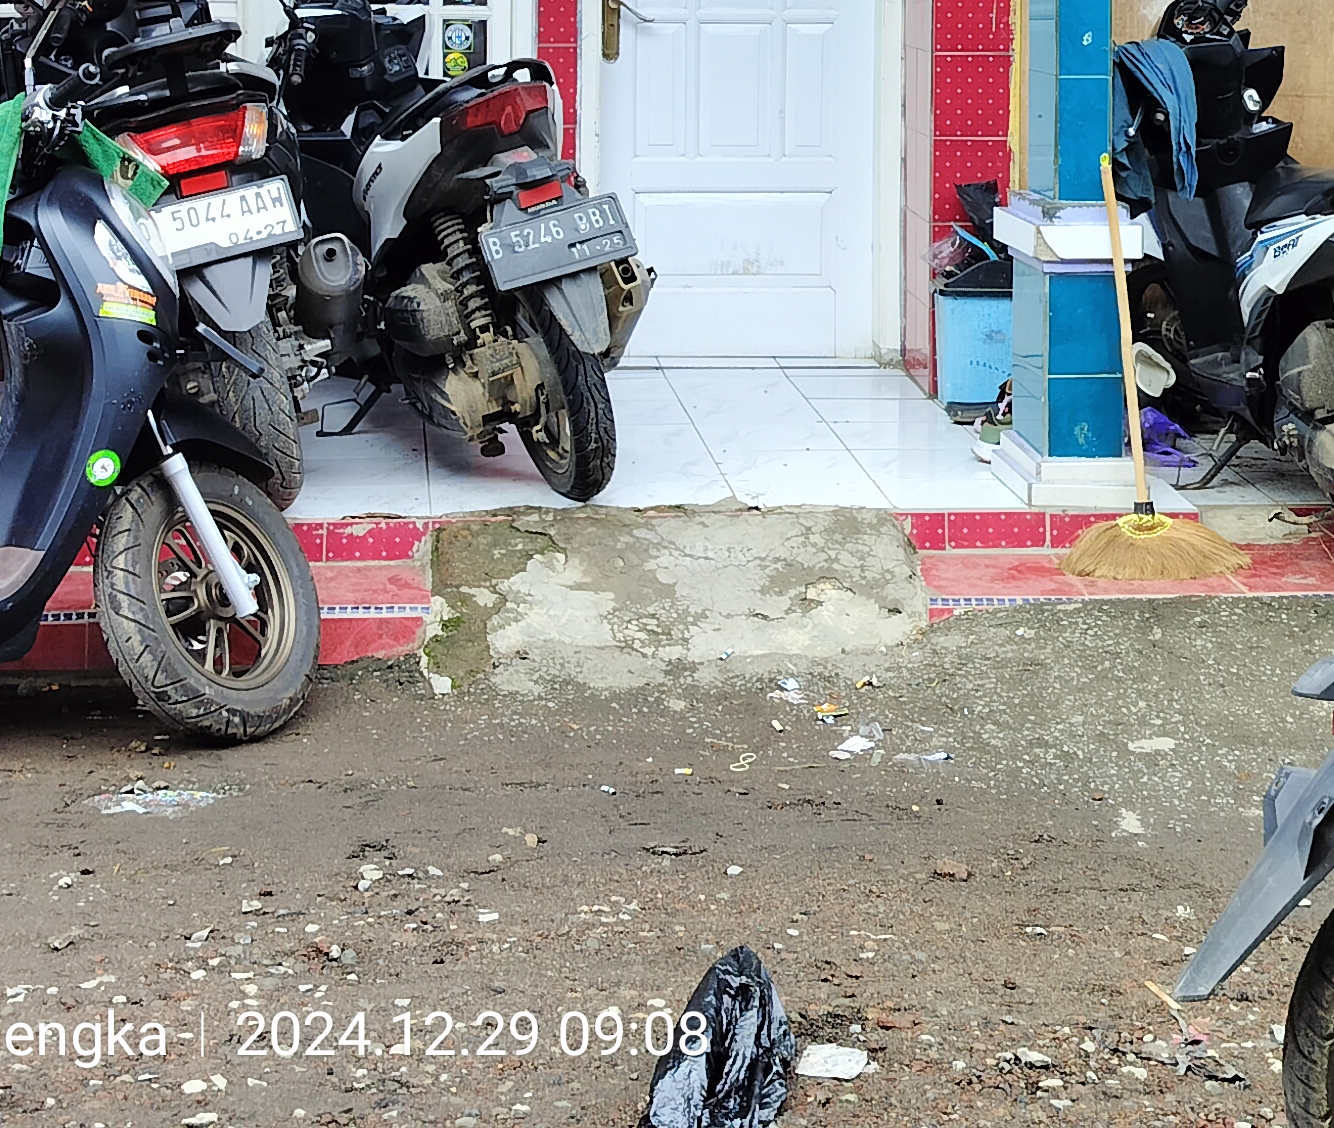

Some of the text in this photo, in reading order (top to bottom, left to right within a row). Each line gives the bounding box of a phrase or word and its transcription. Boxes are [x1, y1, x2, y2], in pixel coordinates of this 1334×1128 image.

[170, 198, 231, 233] 5044
[239, 186, 285, 217] AAW
[488, 237, 503, 260] B
[510, 220, 565, 253] 5246
